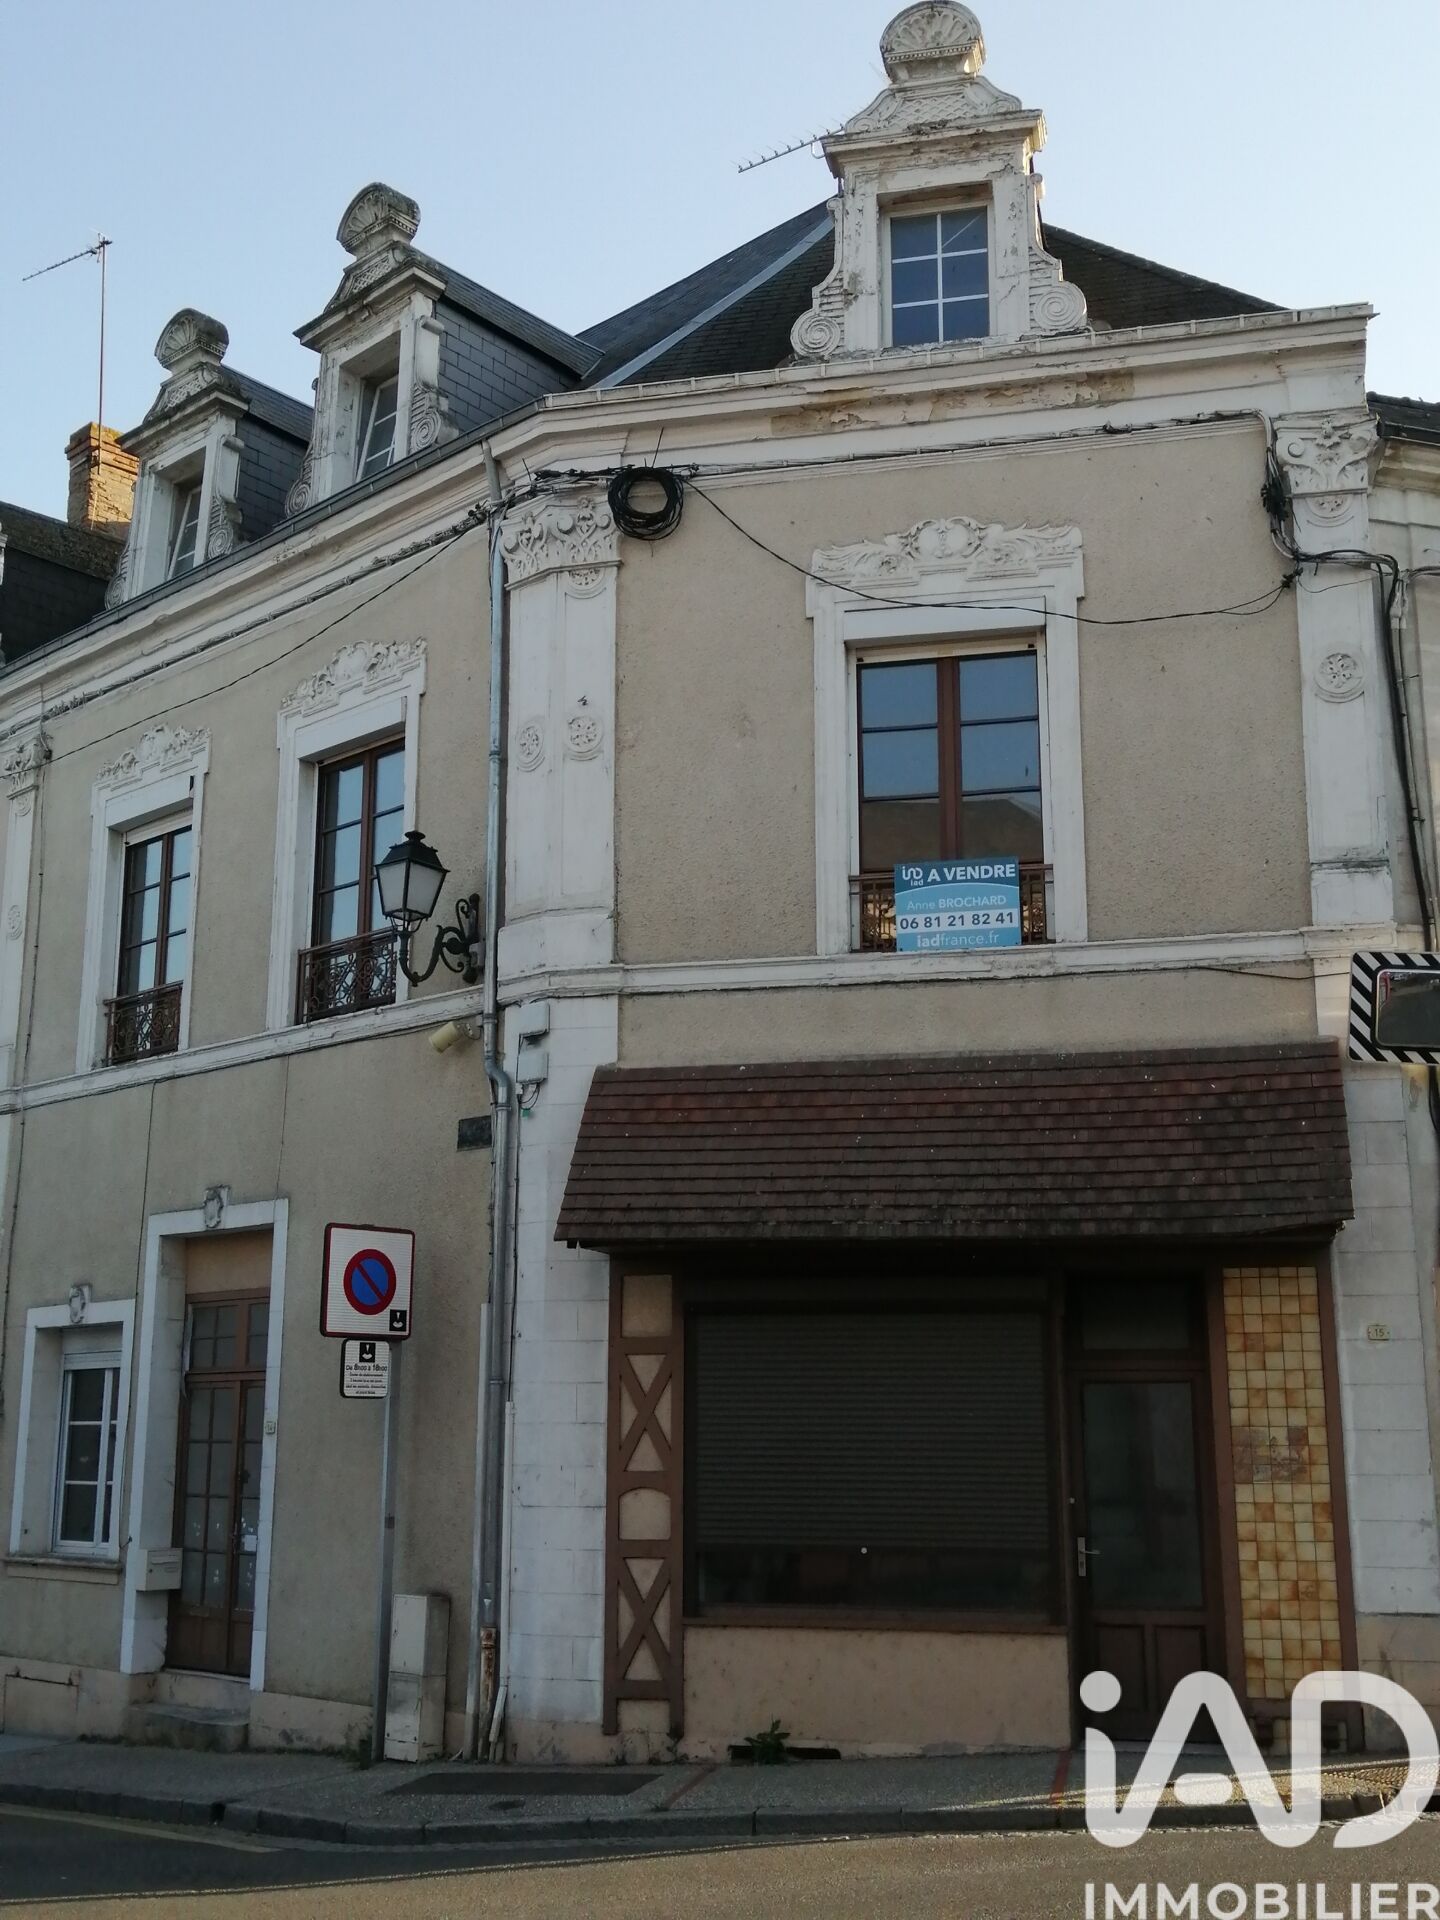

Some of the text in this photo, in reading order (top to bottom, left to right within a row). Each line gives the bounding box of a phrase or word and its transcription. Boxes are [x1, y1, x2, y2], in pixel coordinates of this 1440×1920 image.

[927, 864, 1016, 882] A VENDRE
[907, 896, 1006, 911] Anne BROCHARD
[900, 912, 1013, 930] 06 81 21 82 41
[917, 931, 999, 947] iadfrance.fr
